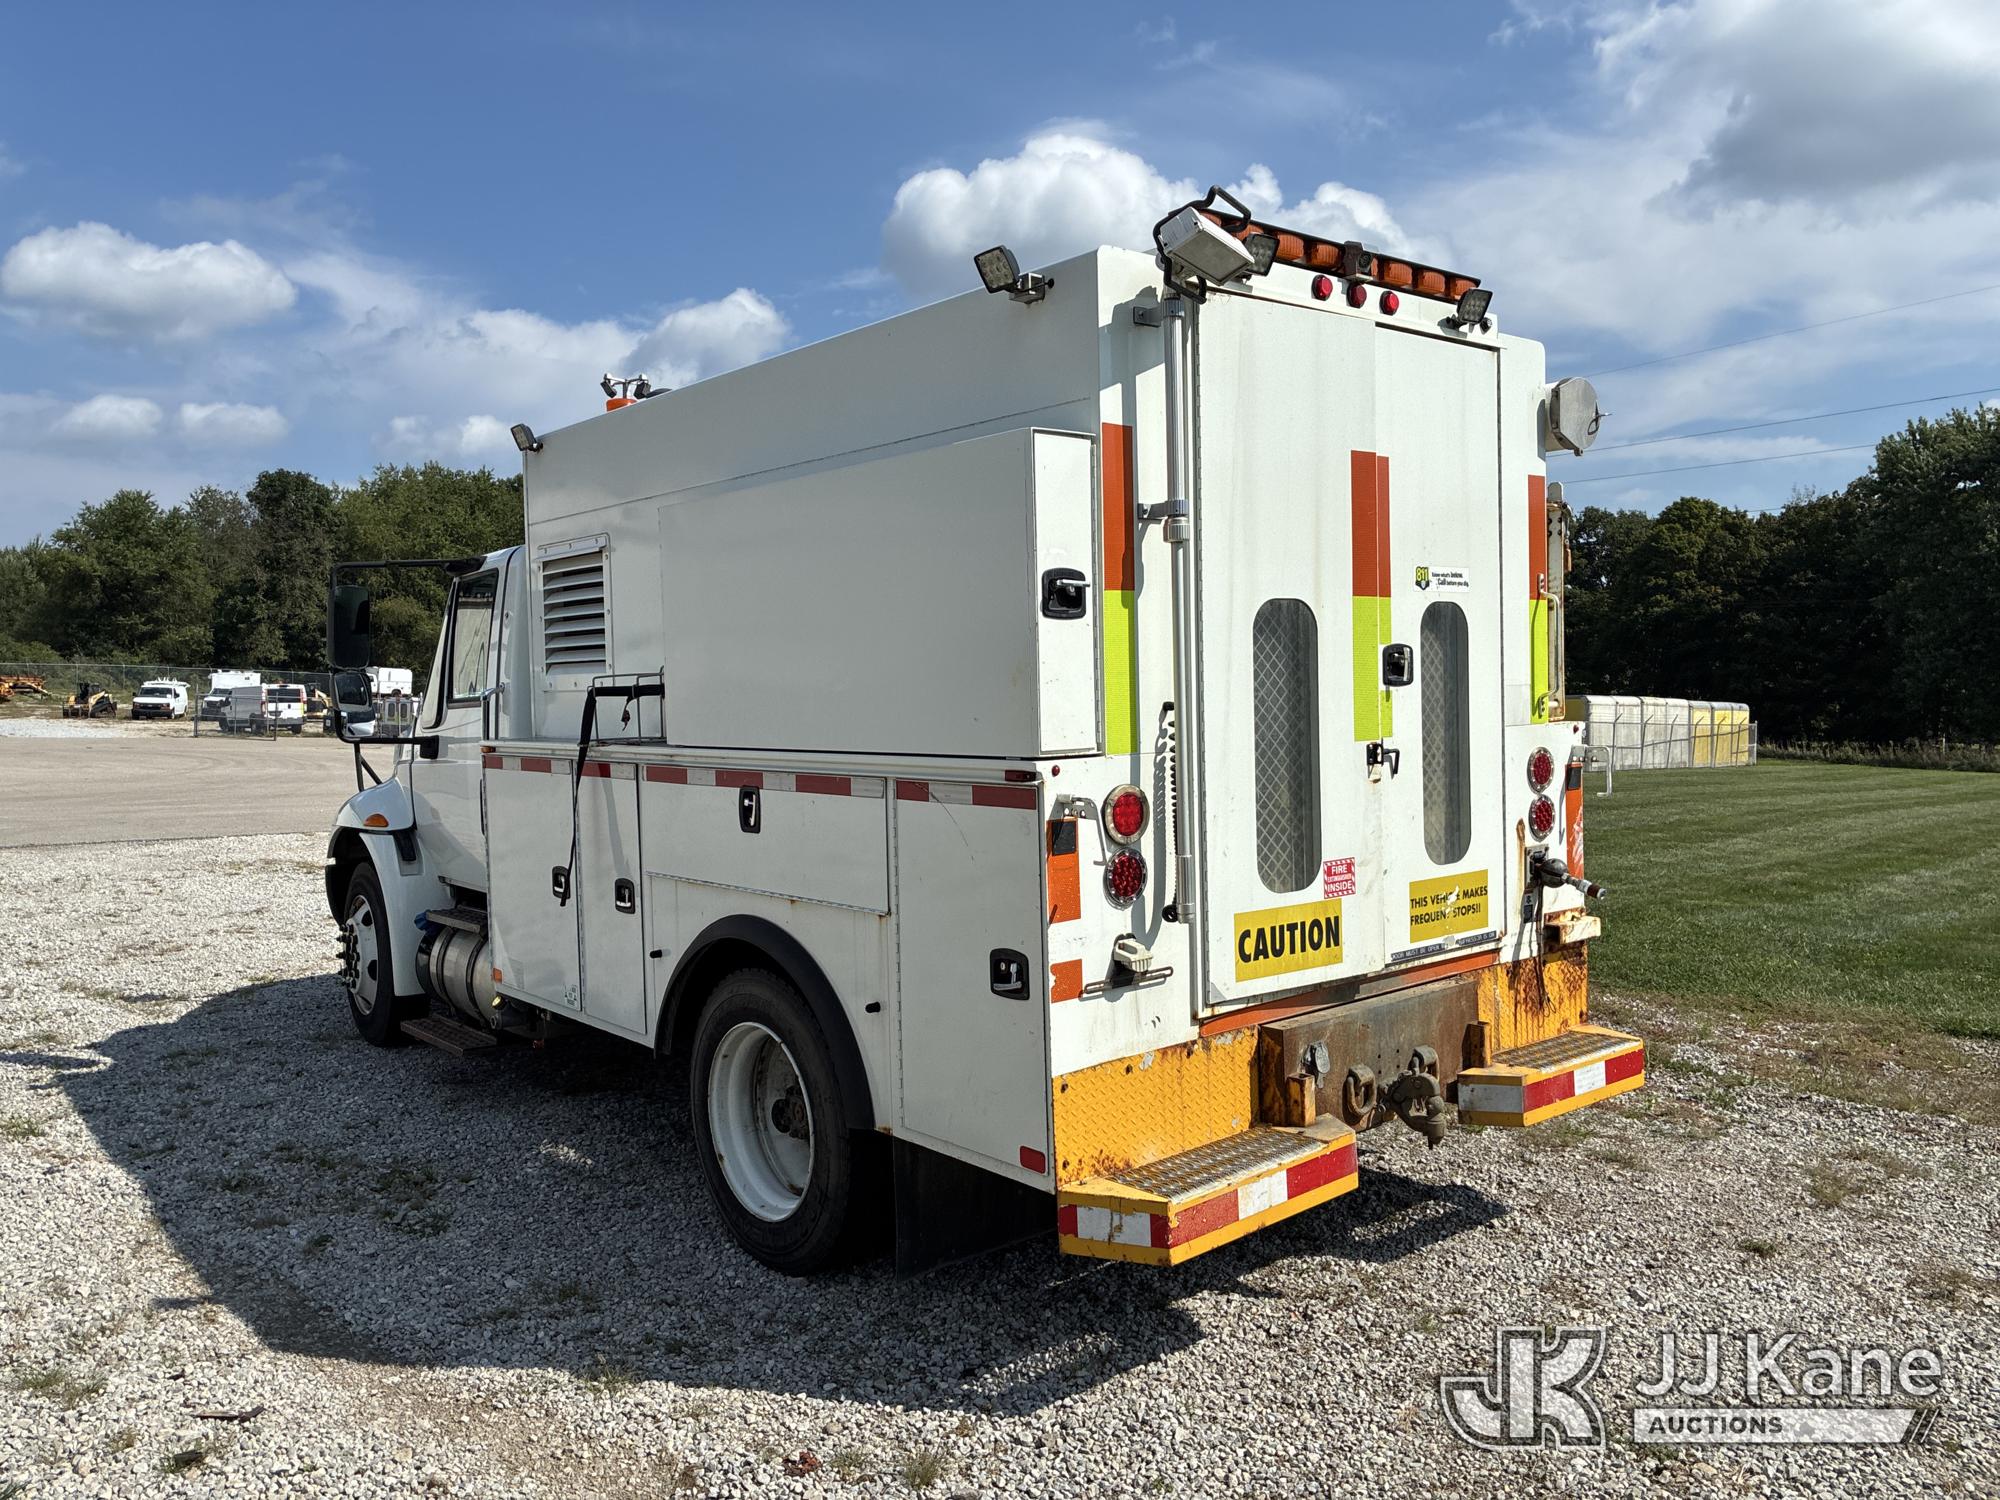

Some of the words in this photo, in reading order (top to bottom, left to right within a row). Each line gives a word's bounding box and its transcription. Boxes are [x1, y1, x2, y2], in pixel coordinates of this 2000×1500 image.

[1416, 566, 1429, 581] 811
[1331, 864, 1348, 875] FIRE
[1328, 880, 1352, 892] INSIDE
[1410, 896, 1428, 909] THIS
[1462, 885, 1488, 899] MAKES
[1410, 910, 1450, 926] FREQUEN
[1453, 903, 1481, 918] STOPS!!
[1238, 915, 1340, 963] CAUTION
[1427, 944, 1440, 952] OPEN
